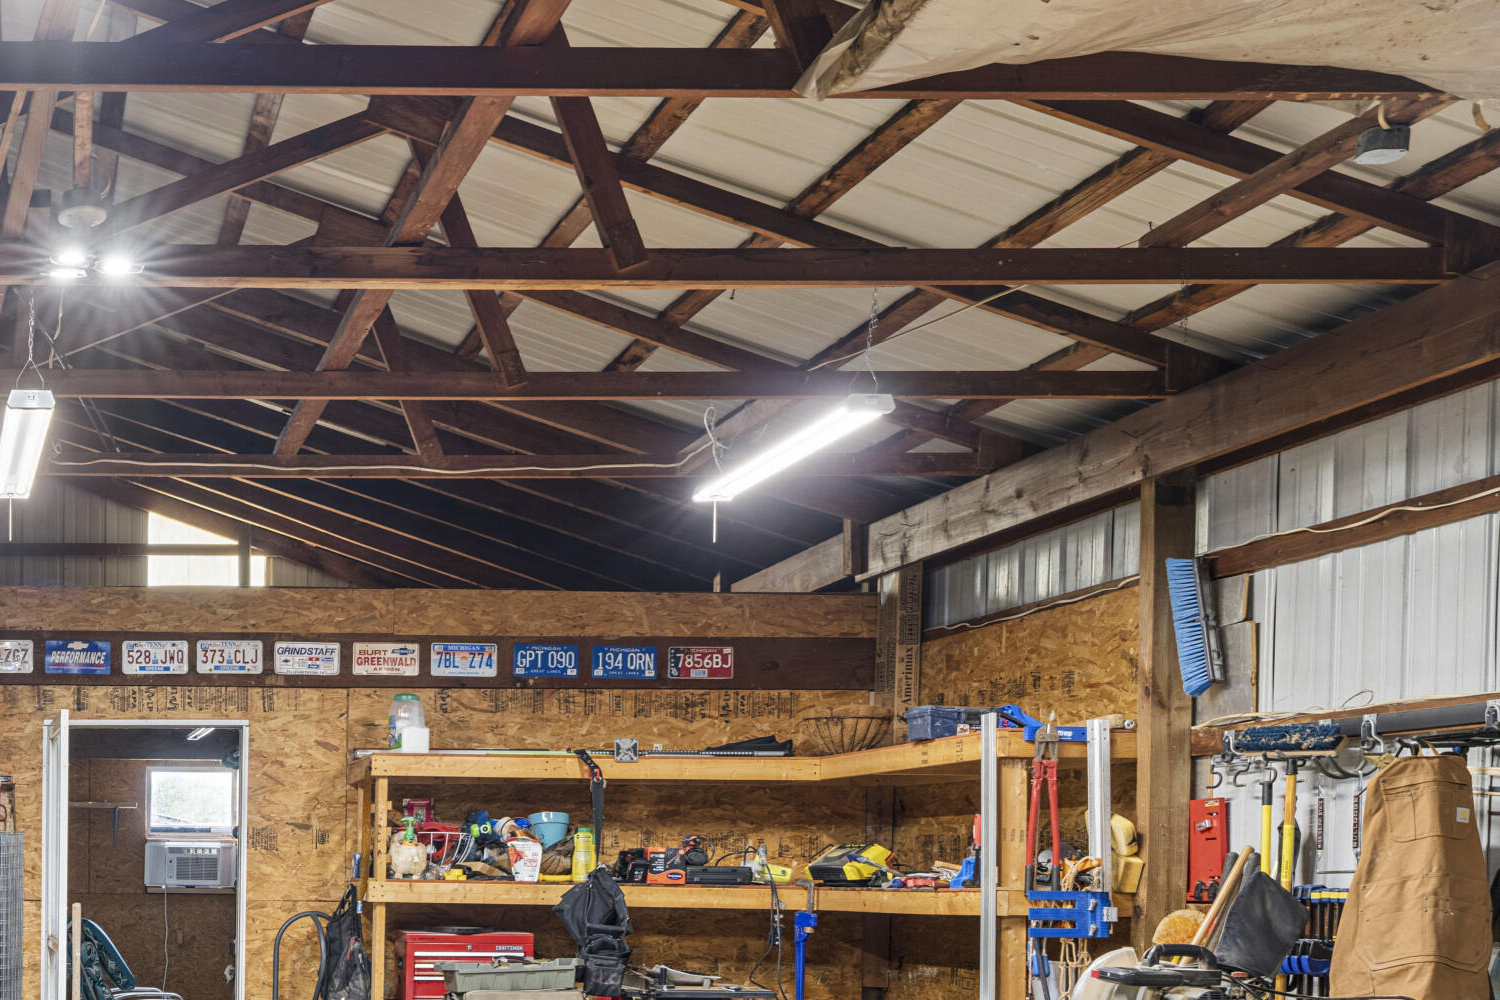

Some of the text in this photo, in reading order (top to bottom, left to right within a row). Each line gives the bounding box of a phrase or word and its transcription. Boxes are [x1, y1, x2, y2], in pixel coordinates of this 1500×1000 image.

[50, 650, 107, 664] PERFORMANCE
[127, 649, 184, 664] 528 JWQ
[201, 649, 258, 664] 373 CLJ
[276, 646, 338, 656] GRINDSTAFF
[356, 656, 417, 667] GREENWALD
[436, 651, 493, 669] 7BL Z74
[517, 650, 575, 668] GPT 090
[597, 652, 623, 670] 194
[676, 653, 732, 668] 7856BJ
[901, 647, 913, 706] Amerimax
